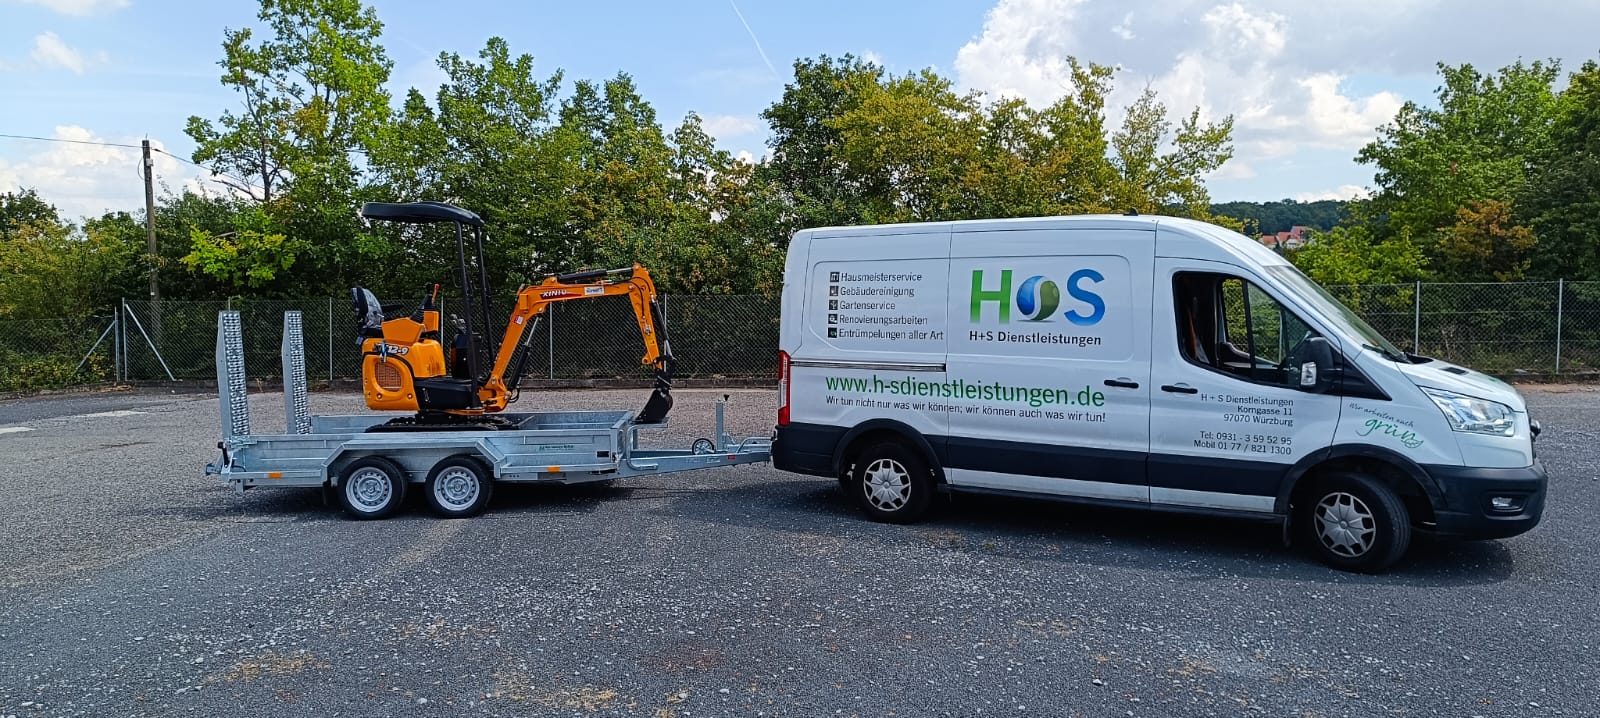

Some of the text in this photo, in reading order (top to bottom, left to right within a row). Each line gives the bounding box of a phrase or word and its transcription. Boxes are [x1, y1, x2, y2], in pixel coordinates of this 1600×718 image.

[841, 272, 922, 282] Hausmeisterservice
[840, 286, 915, 297] Gebäudereinigung
[840, 300, 896, 310] Gartenservice
[839, 314, 928, 326] Renovierungsarbeiten
[839, 328, 944, 341] Entrümpelungen aller Art
[969, 330, 1101, 347] H+S Dienstleistungen
[825, 374, 1105, 408] www.h-sdienstleistungen.de
[1201, 393, 1208, 401] H
[1218, 394, 1224, 402] S
[1225, 394, 1294, 408] Dienstleistungen
[825, 395, 1106, 423] Wir tun nicht nur was wir können; wir können auch was wir tun!
[1237, 405, 1293, 416] Korngasse 11
[1223, 413, 1251, 423] 97070
[1355, 419, 1416, 440] grün
[1199, 430, 1214, 439] Tel:
[1216, 432, 1236, 441] 0931
[1245, 434, 1251, 443] 3
[1253, 435, 1264, 443] 59
[1266, 435, 1278, 444] 52
[1280, 436, 1292, 446] 95
[1193, 439, 1216, 448] Mobil
[1217, 441, 1228, 450] 01
[1230, 442, 1242, 451] 77
[1251, 444, 1266, 453] 821
[1270, 445, 1292, 455] 1300
